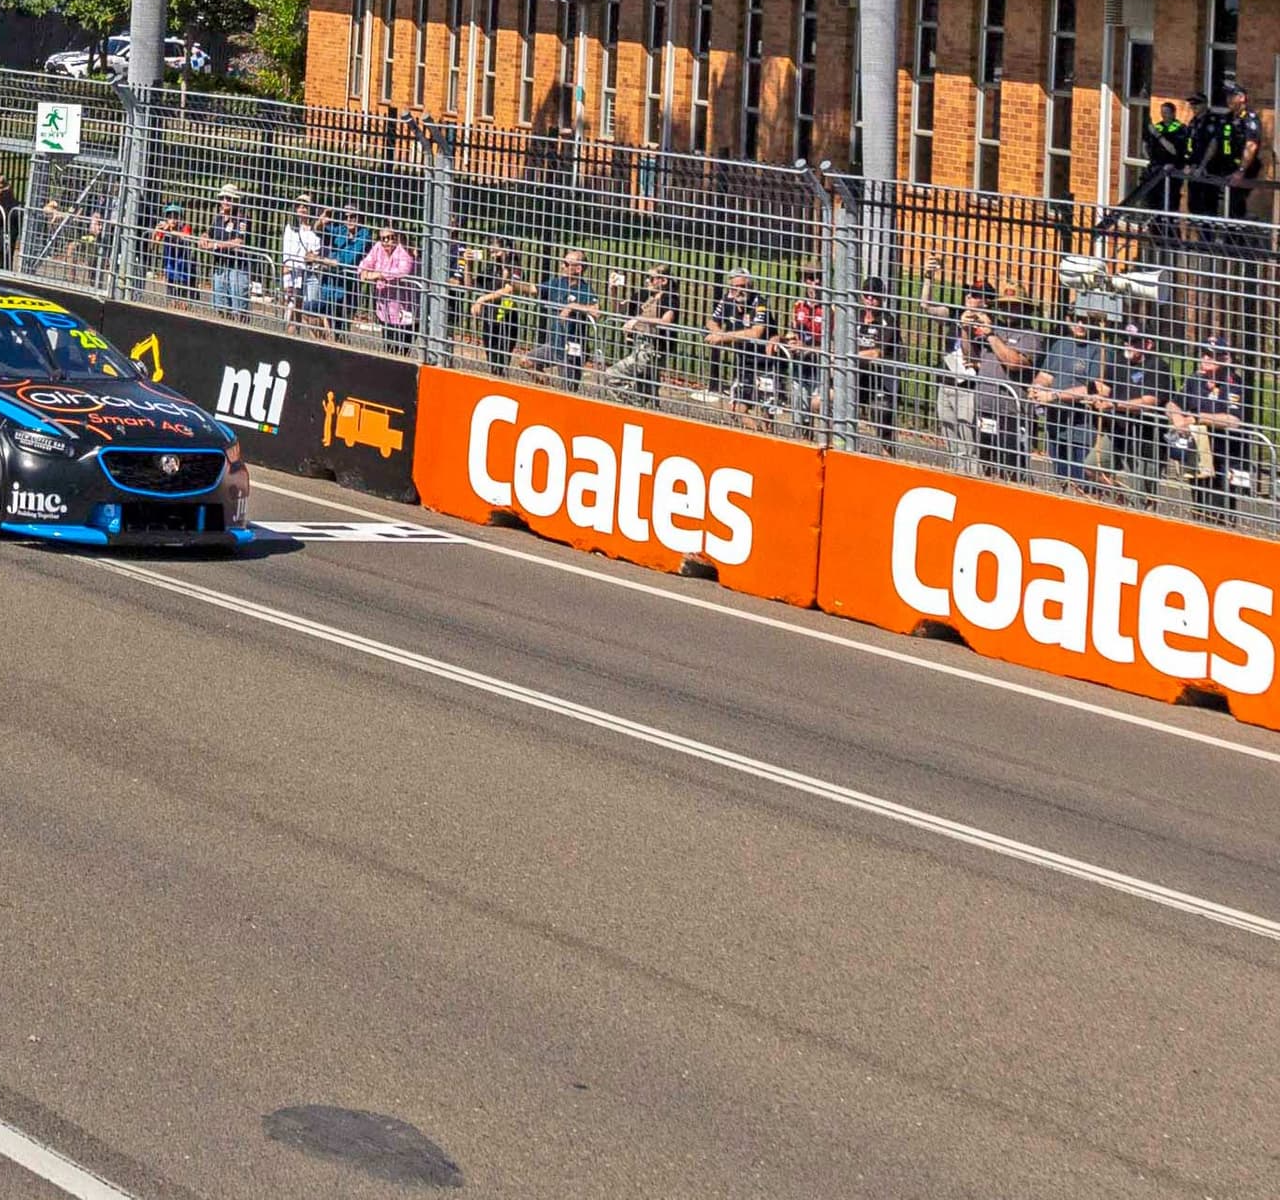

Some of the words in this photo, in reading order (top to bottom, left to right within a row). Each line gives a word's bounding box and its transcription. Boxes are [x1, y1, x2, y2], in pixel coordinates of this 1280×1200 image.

[69, 329, 108, 350] 26
[29, 391, 206, 421] airtouch
[219, 360, 291, 426] nti
[87, 413, 155, 427] Smart
[162, 422, 194, 437] AC
[468, 394, 754, 566] Coates
[7, 482, 67, 515] jmc.
[892, 486, 1276, 696] Coates
